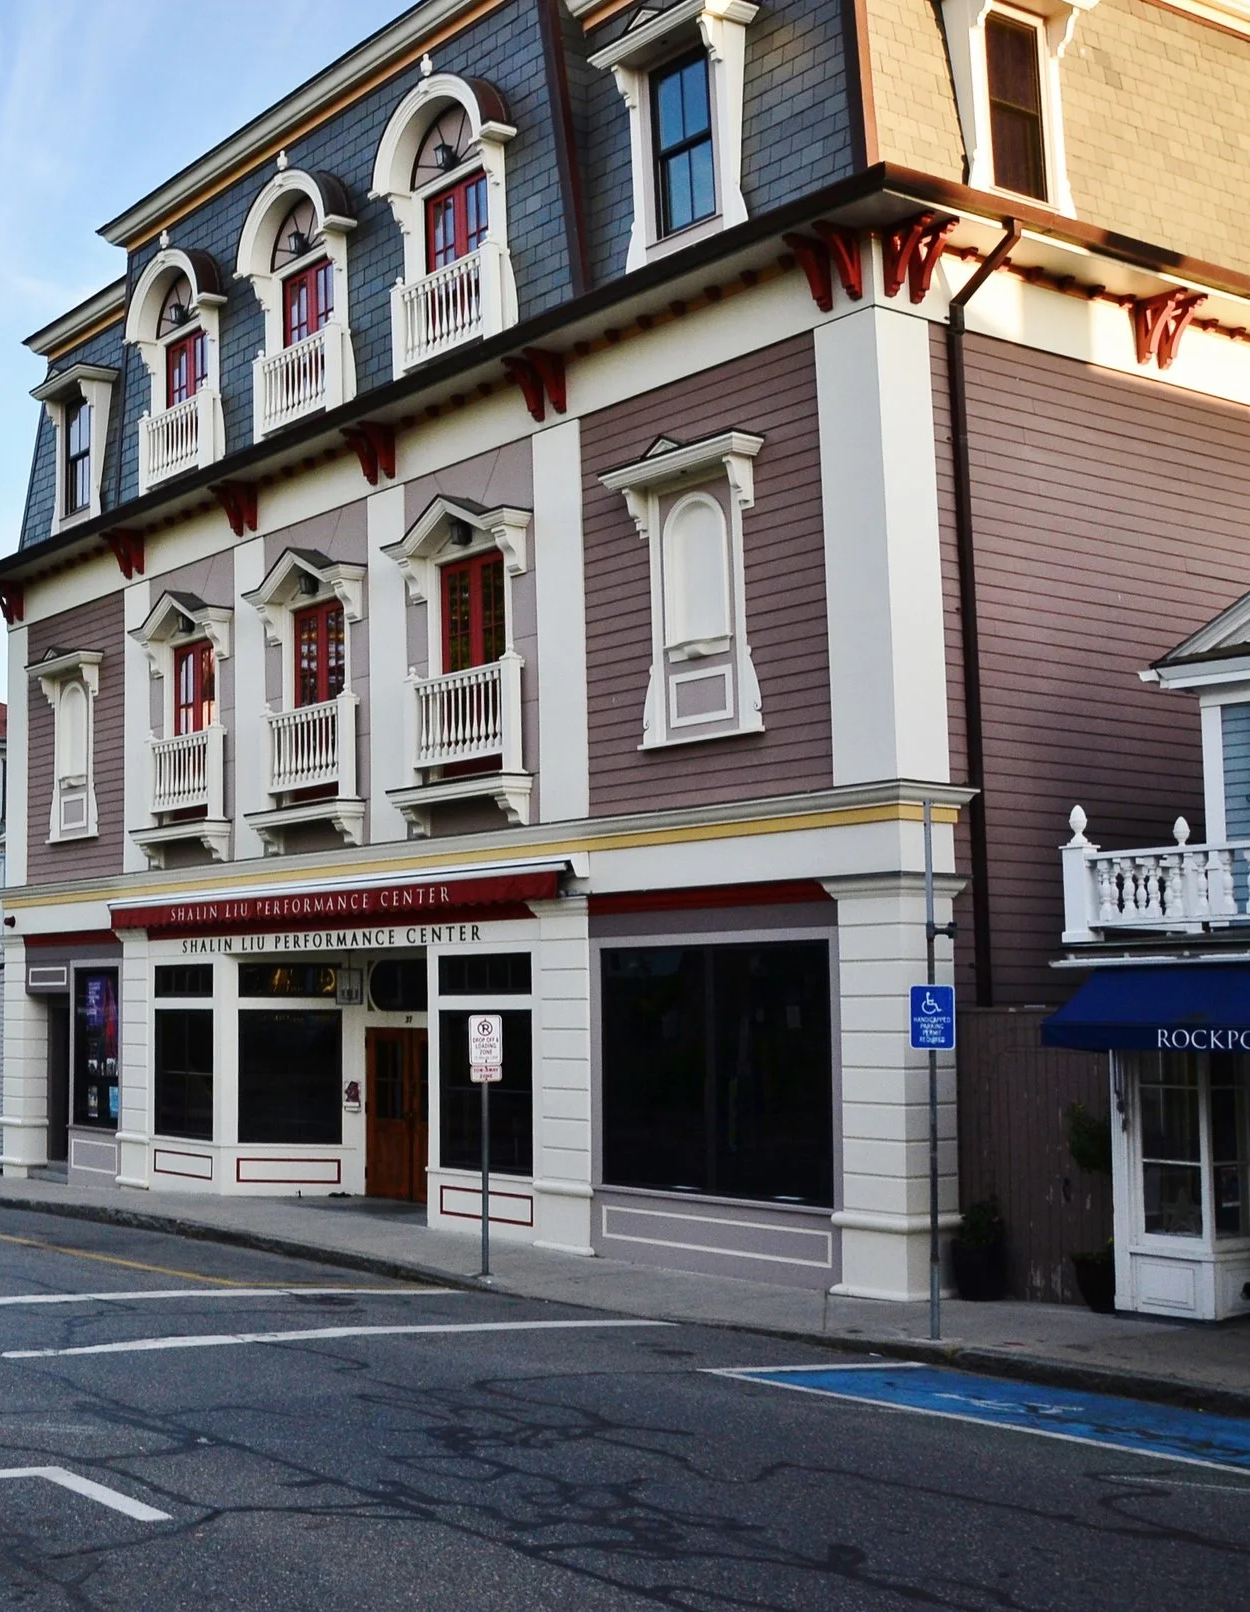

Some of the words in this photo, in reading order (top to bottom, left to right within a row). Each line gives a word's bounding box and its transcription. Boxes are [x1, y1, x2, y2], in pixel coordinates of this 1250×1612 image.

[170, 904, 217, 921] SHALIN
[225, 902, 249, 918] LIU
[256, 893, 368, 917] PERFORMANCE
[380, 886, 450, 907] CENTER
[182, 937, 233, 954] SHALIN
[241, 935, 266, 951] LIU
[274, 929, 395, 949] PERFORMANCE
[406, 924, 482, 944] CENTER
